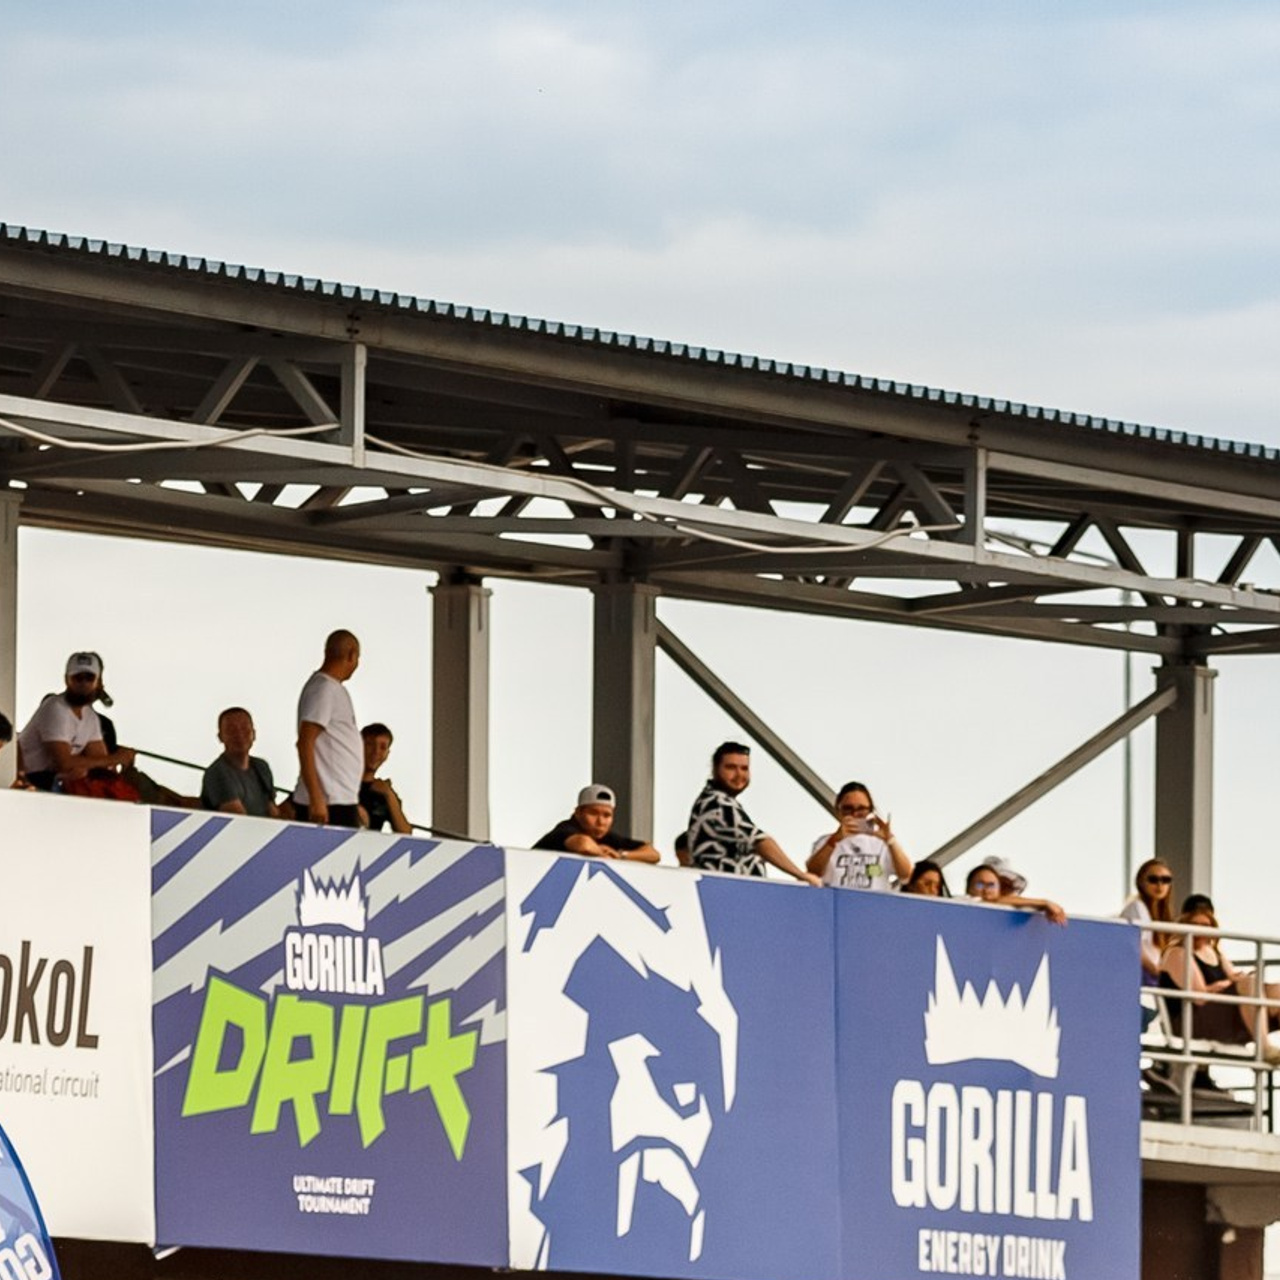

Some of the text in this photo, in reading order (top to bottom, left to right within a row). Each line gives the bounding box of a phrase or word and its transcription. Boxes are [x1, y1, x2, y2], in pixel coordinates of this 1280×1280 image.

[286, 931, 385, 996] GORILLA
[0, 1066, 99, 1098] tional circuit
[182, 974, 479, 1162] DRIFT
[891, 1078, 1094, 1223] GORILLA
[293, 1175, 375, 1197] ULTIMATE DRIFT
[297, 1194, 371, 1215] TOURNAMENT
[918, 1228, 1001, 1277] ENERGY
